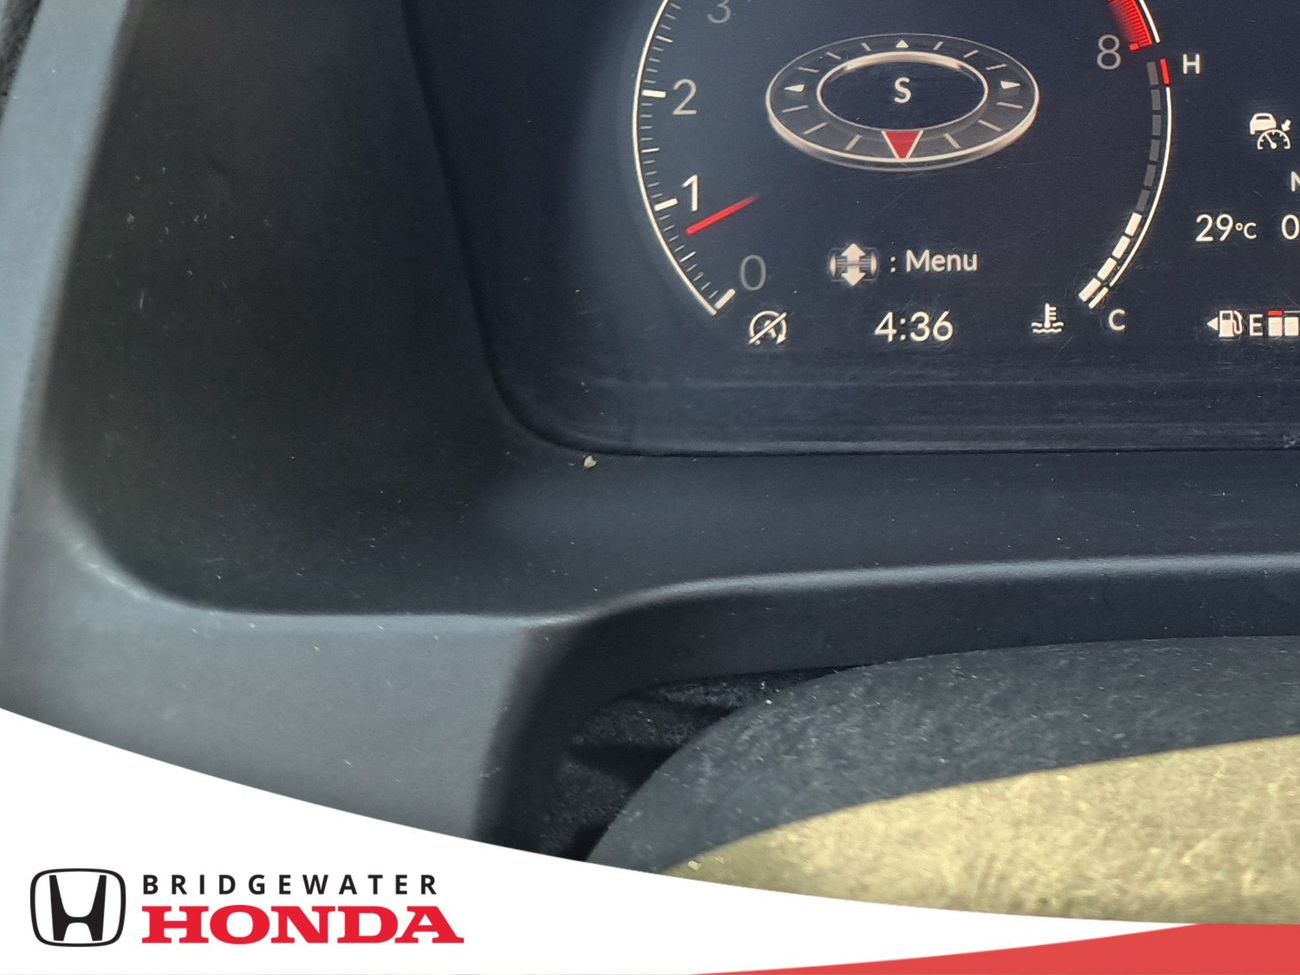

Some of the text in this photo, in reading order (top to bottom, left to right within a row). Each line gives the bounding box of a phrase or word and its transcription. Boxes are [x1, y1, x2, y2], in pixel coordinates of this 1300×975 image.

[1097, 35, 1120, 69] 8
[1183, 54, 1200, 74] H
[673, 79, 696, 114] 2
[895, 77, 911, 103] S
[683, 175, 697, 211] 1
[740, 255, 766, 290] 0
[906, 250, 977, 272] Menu
[875, 311, 953, 342] 4:36
[1109, 309, 1125, 330] C
[1250, 314, 1263, 336] E
